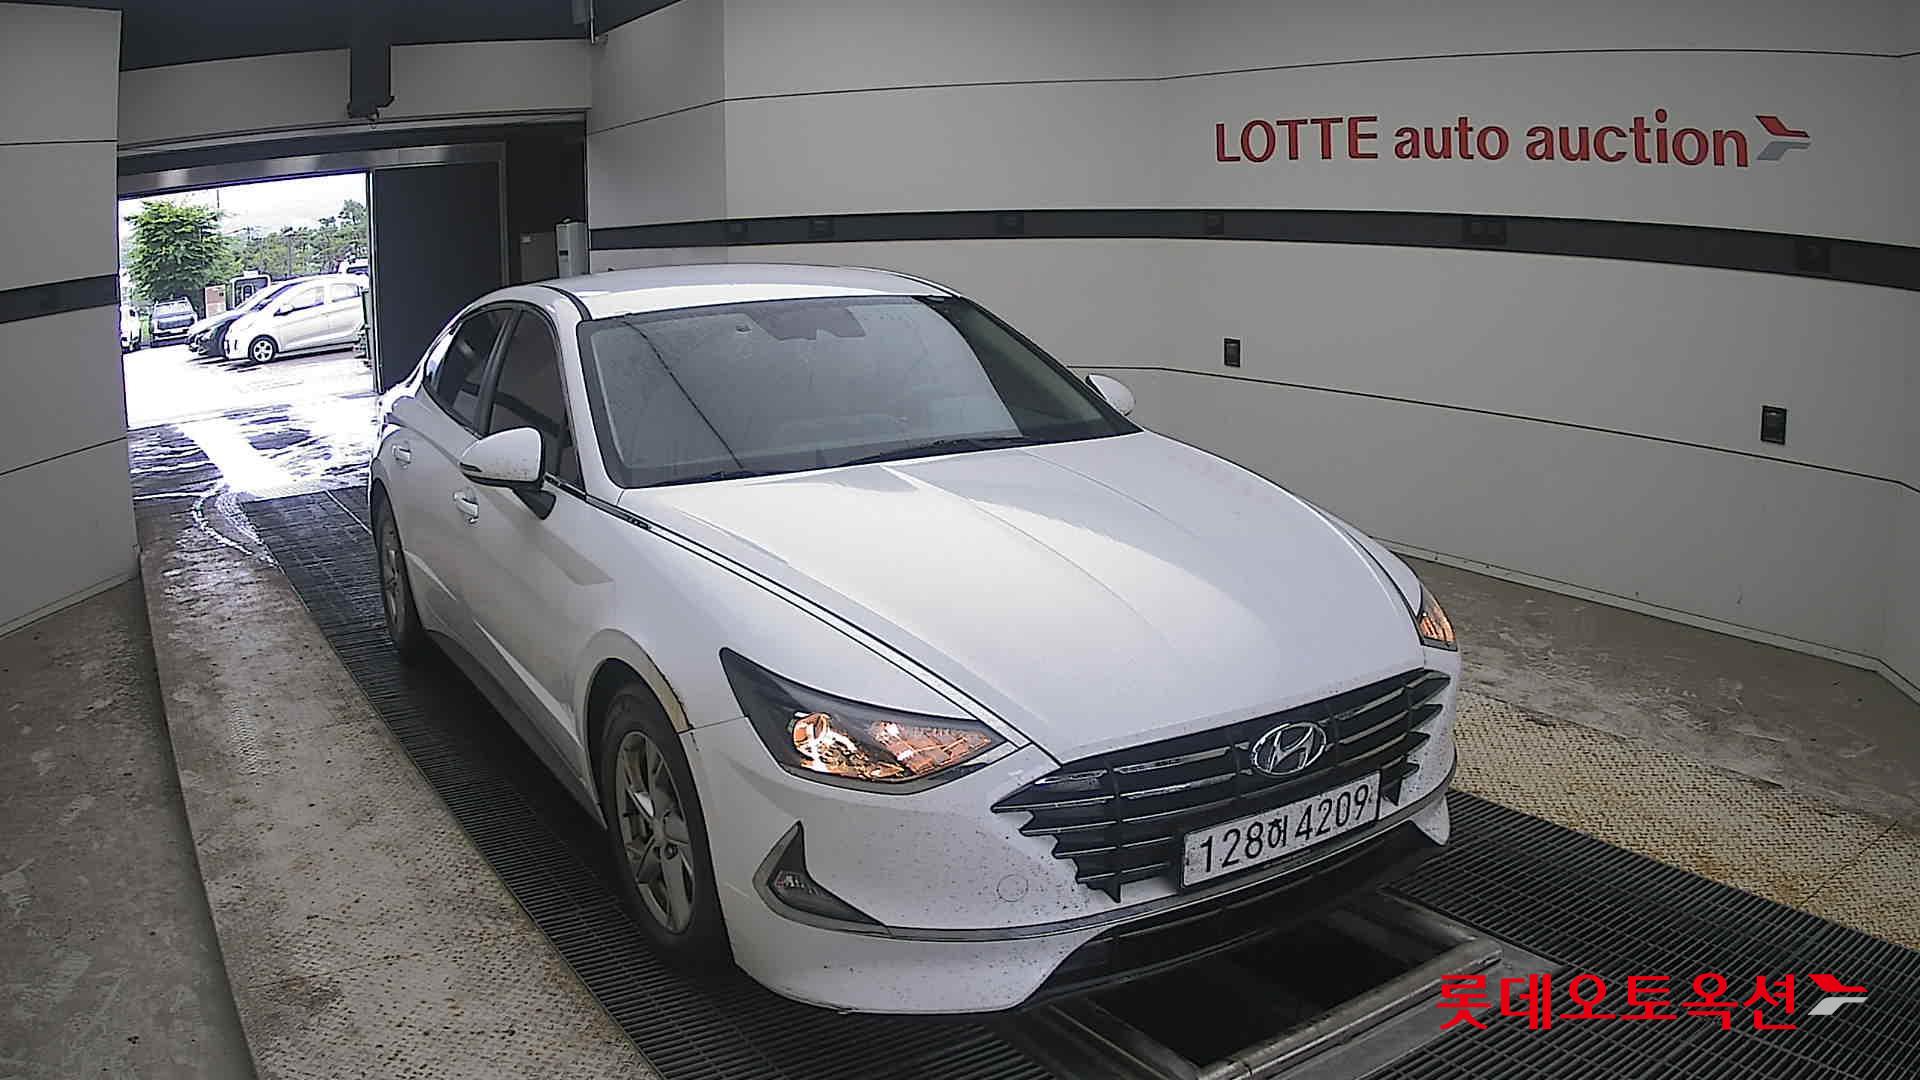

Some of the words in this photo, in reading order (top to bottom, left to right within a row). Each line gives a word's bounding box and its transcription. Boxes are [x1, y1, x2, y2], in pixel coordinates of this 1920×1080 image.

[1215, 115, 1378, 163] LOTTE
[1393, 116, 1510, 161] auto
[1525, 108, 1749, 168] auction
[1294, 784, 1370, 841] 4209
